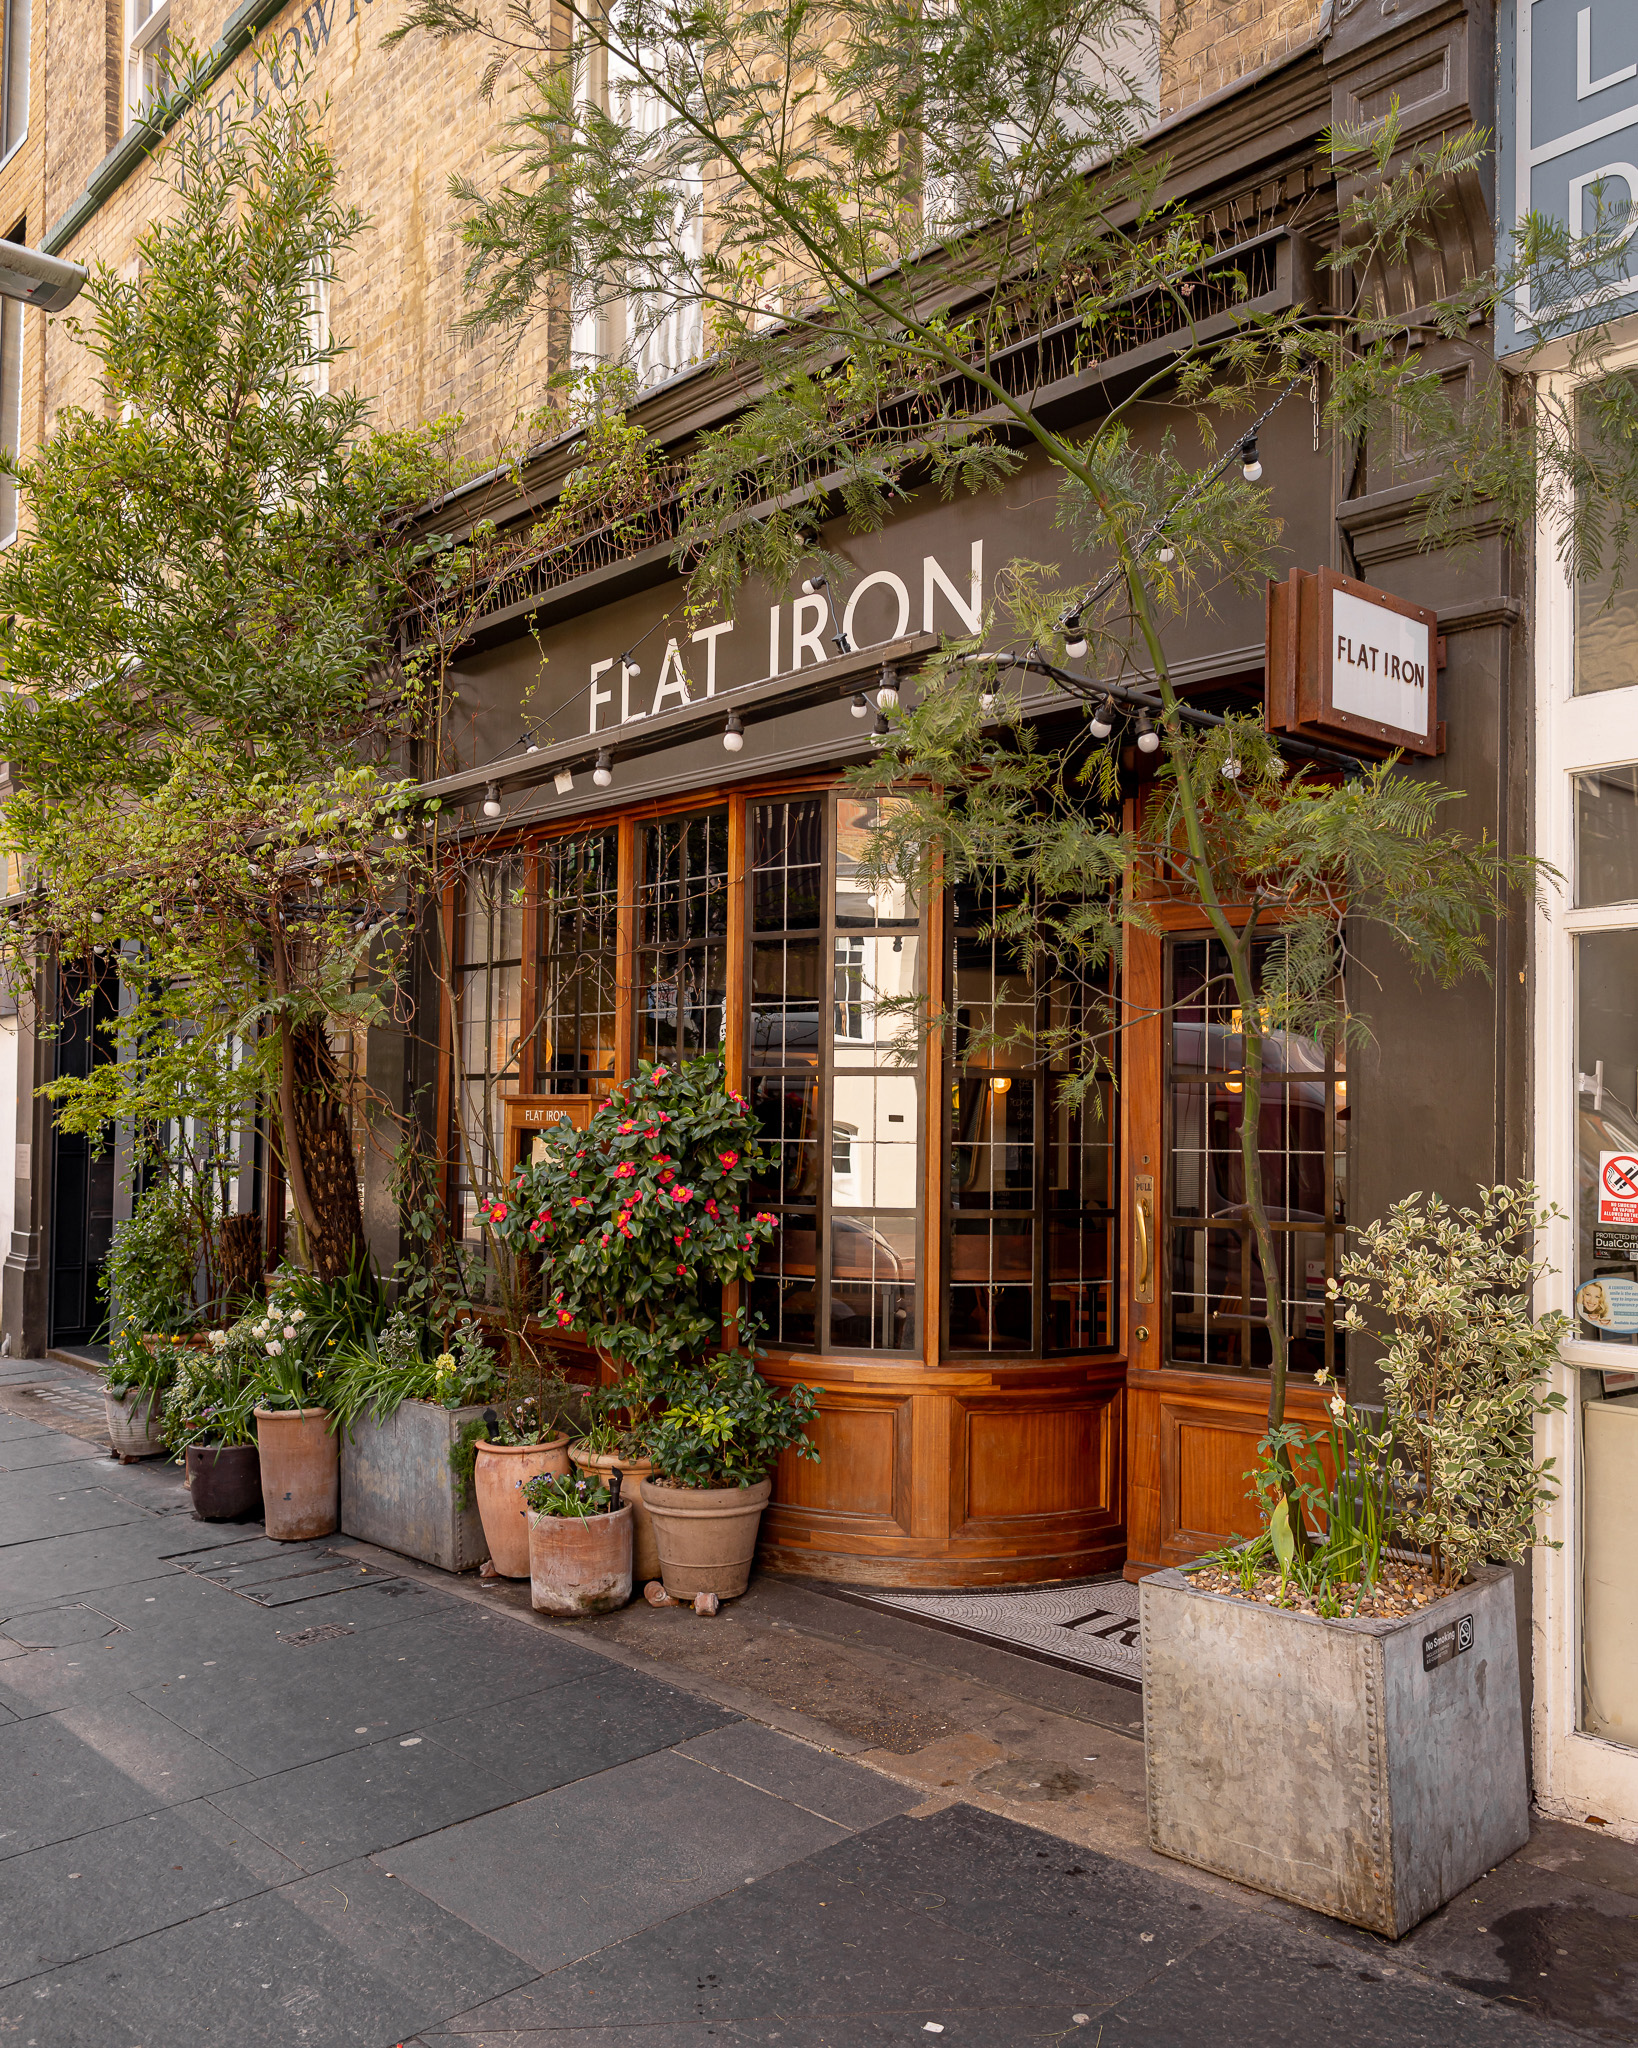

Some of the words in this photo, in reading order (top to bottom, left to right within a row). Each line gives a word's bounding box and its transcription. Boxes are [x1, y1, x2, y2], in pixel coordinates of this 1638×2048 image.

[589, 620, 734, 734] FLAT
[769, 539, 984, 678] IRON
[1337, 635, 1379, 672] FLAT
[1384, 652, 1425, 688] IRON
[525, 1110, 544, 1121] FLAT
[1136, 1182, 1152, 1191] PULL
[1596, 1232, 1630, 1240] PROTECTED
[1425, 1641, 1434, 1651] No
[1434, 1630, 1455, 1648] Smoking
